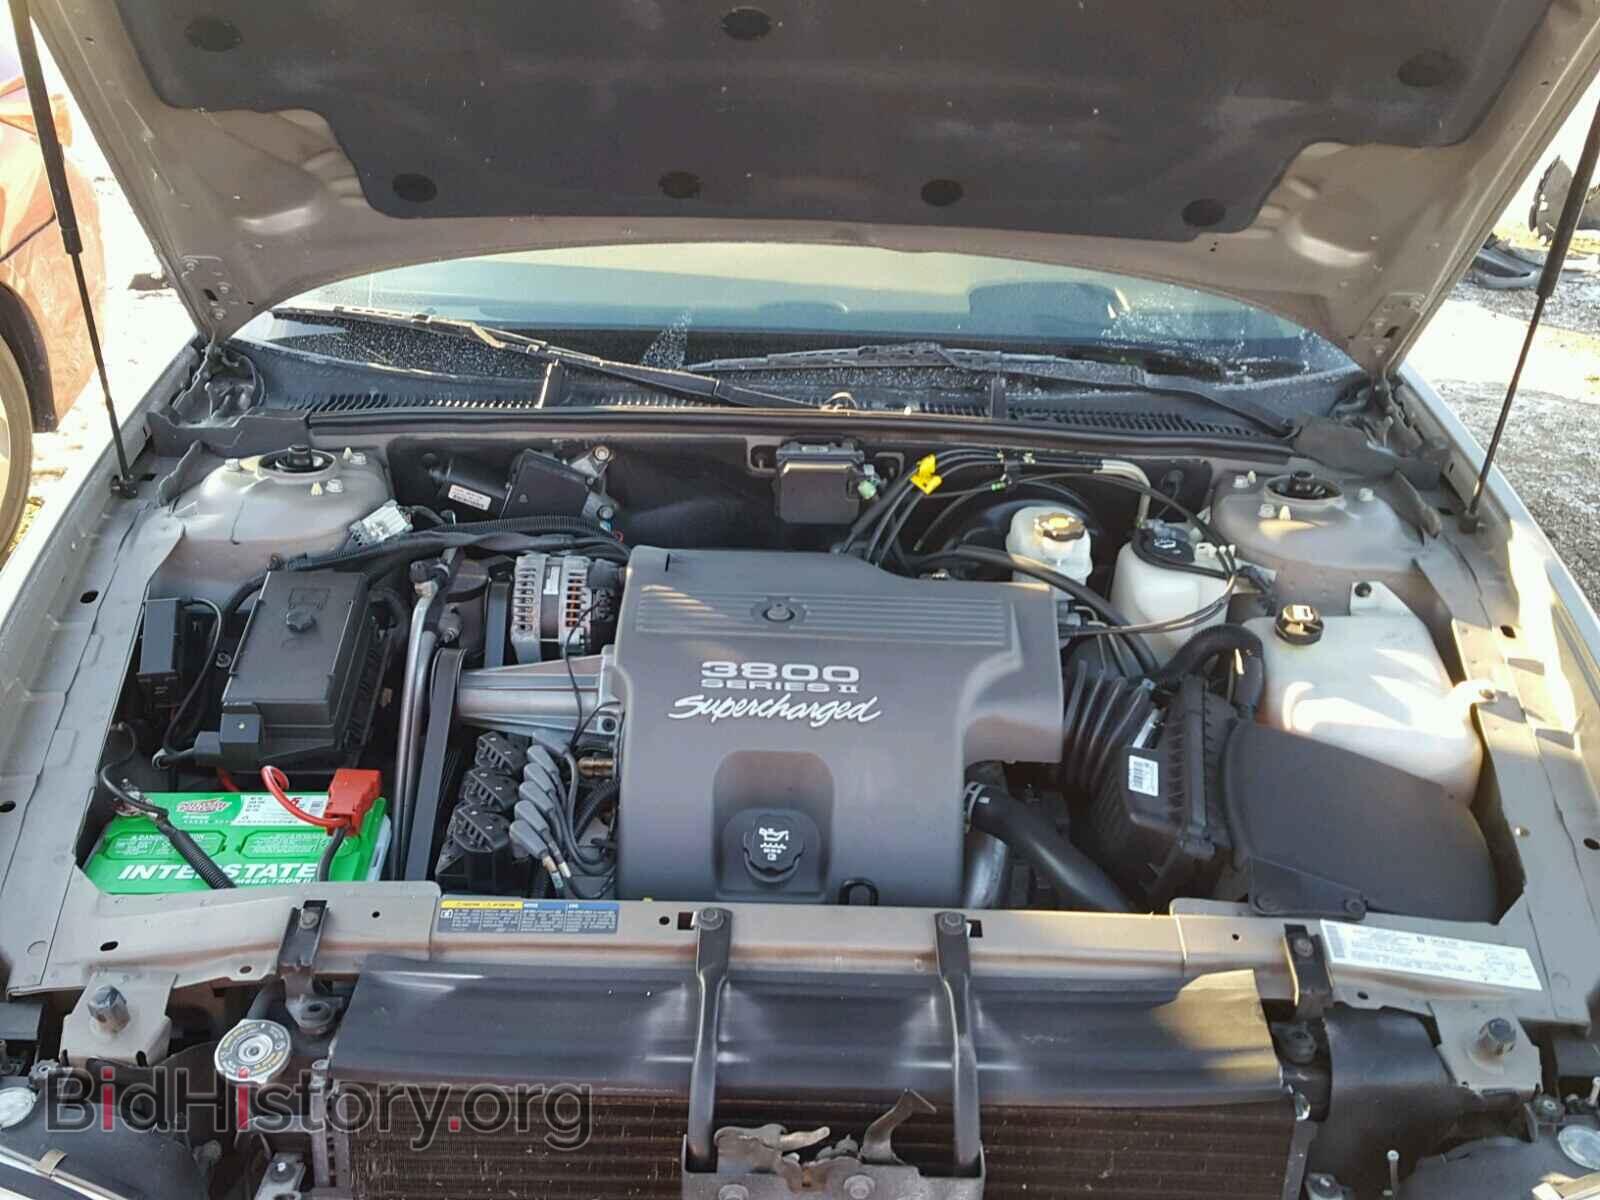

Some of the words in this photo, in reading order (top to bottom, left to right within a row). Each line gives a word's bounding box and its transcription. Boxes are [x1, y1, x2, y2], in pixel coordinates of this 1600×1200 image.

[701, 661, 860, 683] 3800
[701, 678, 830, 693] SERIES
[668, 692, 882, 727] Supercharged
[117, 863, 318, 880] INTESTATE
